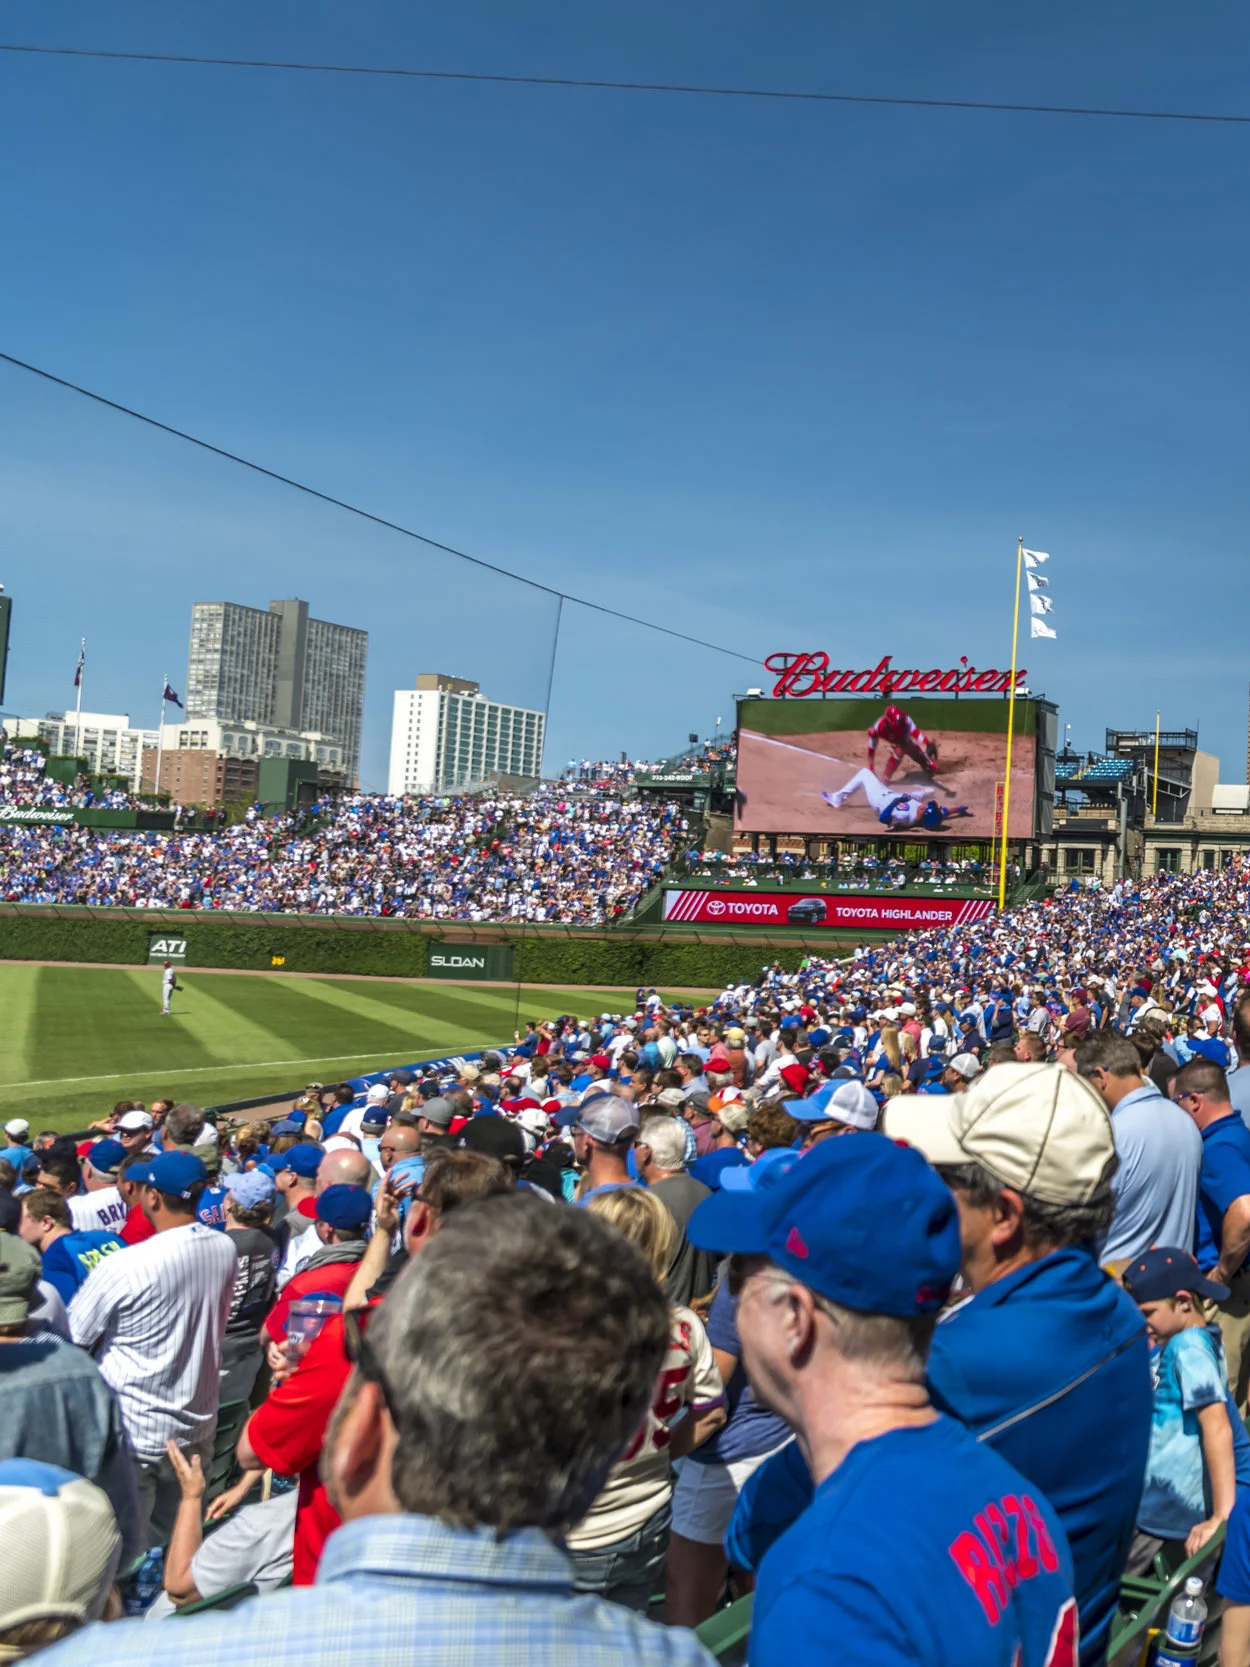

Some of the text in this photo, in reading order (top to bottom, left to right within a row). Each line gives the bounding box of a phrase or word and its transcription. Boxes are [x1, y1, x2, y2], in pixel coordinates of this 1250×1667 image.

[764, 651, 1028, 698] Budweiser
[0, 805, 74, 821] Budweiser
[727, 902, 778, 916] TOYOTA
[836, 907, 953, 921] TOYOTA HIGHLANDER
[151, 940, 187, 953] ATI
[431, 955, 485, 968] SLOAN
